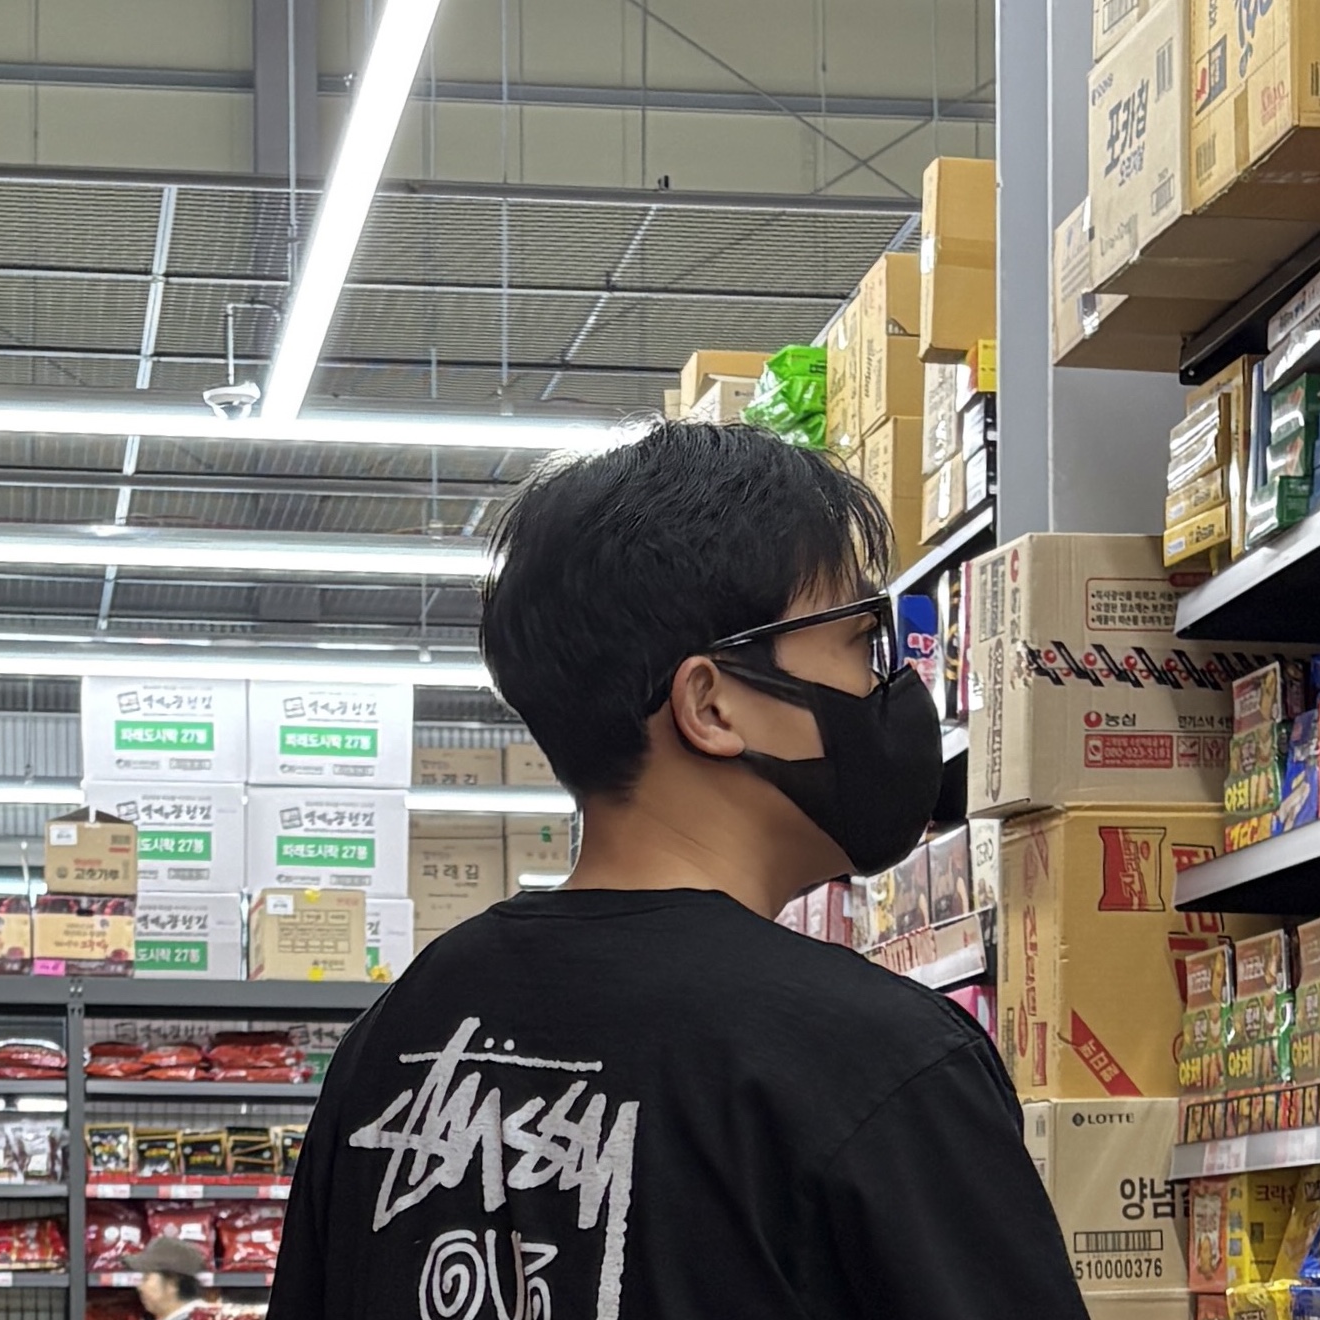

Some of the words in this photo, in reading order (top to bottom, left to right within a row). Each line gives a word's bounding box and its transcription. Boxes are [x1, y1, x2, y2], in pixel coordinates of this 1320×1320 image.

[1104, 78, 1151, 180] 포카칩
[1104, 712, 1137, 728] 농심
[137, 837, 176, 853] 도시락
[74, 867, 120, 882] 고춧가루
[422, 862, 480, 884] 파래김
[136, 947, 172, 963] 도시락
[1087, 1112, 1136, 1126] LOTTE
